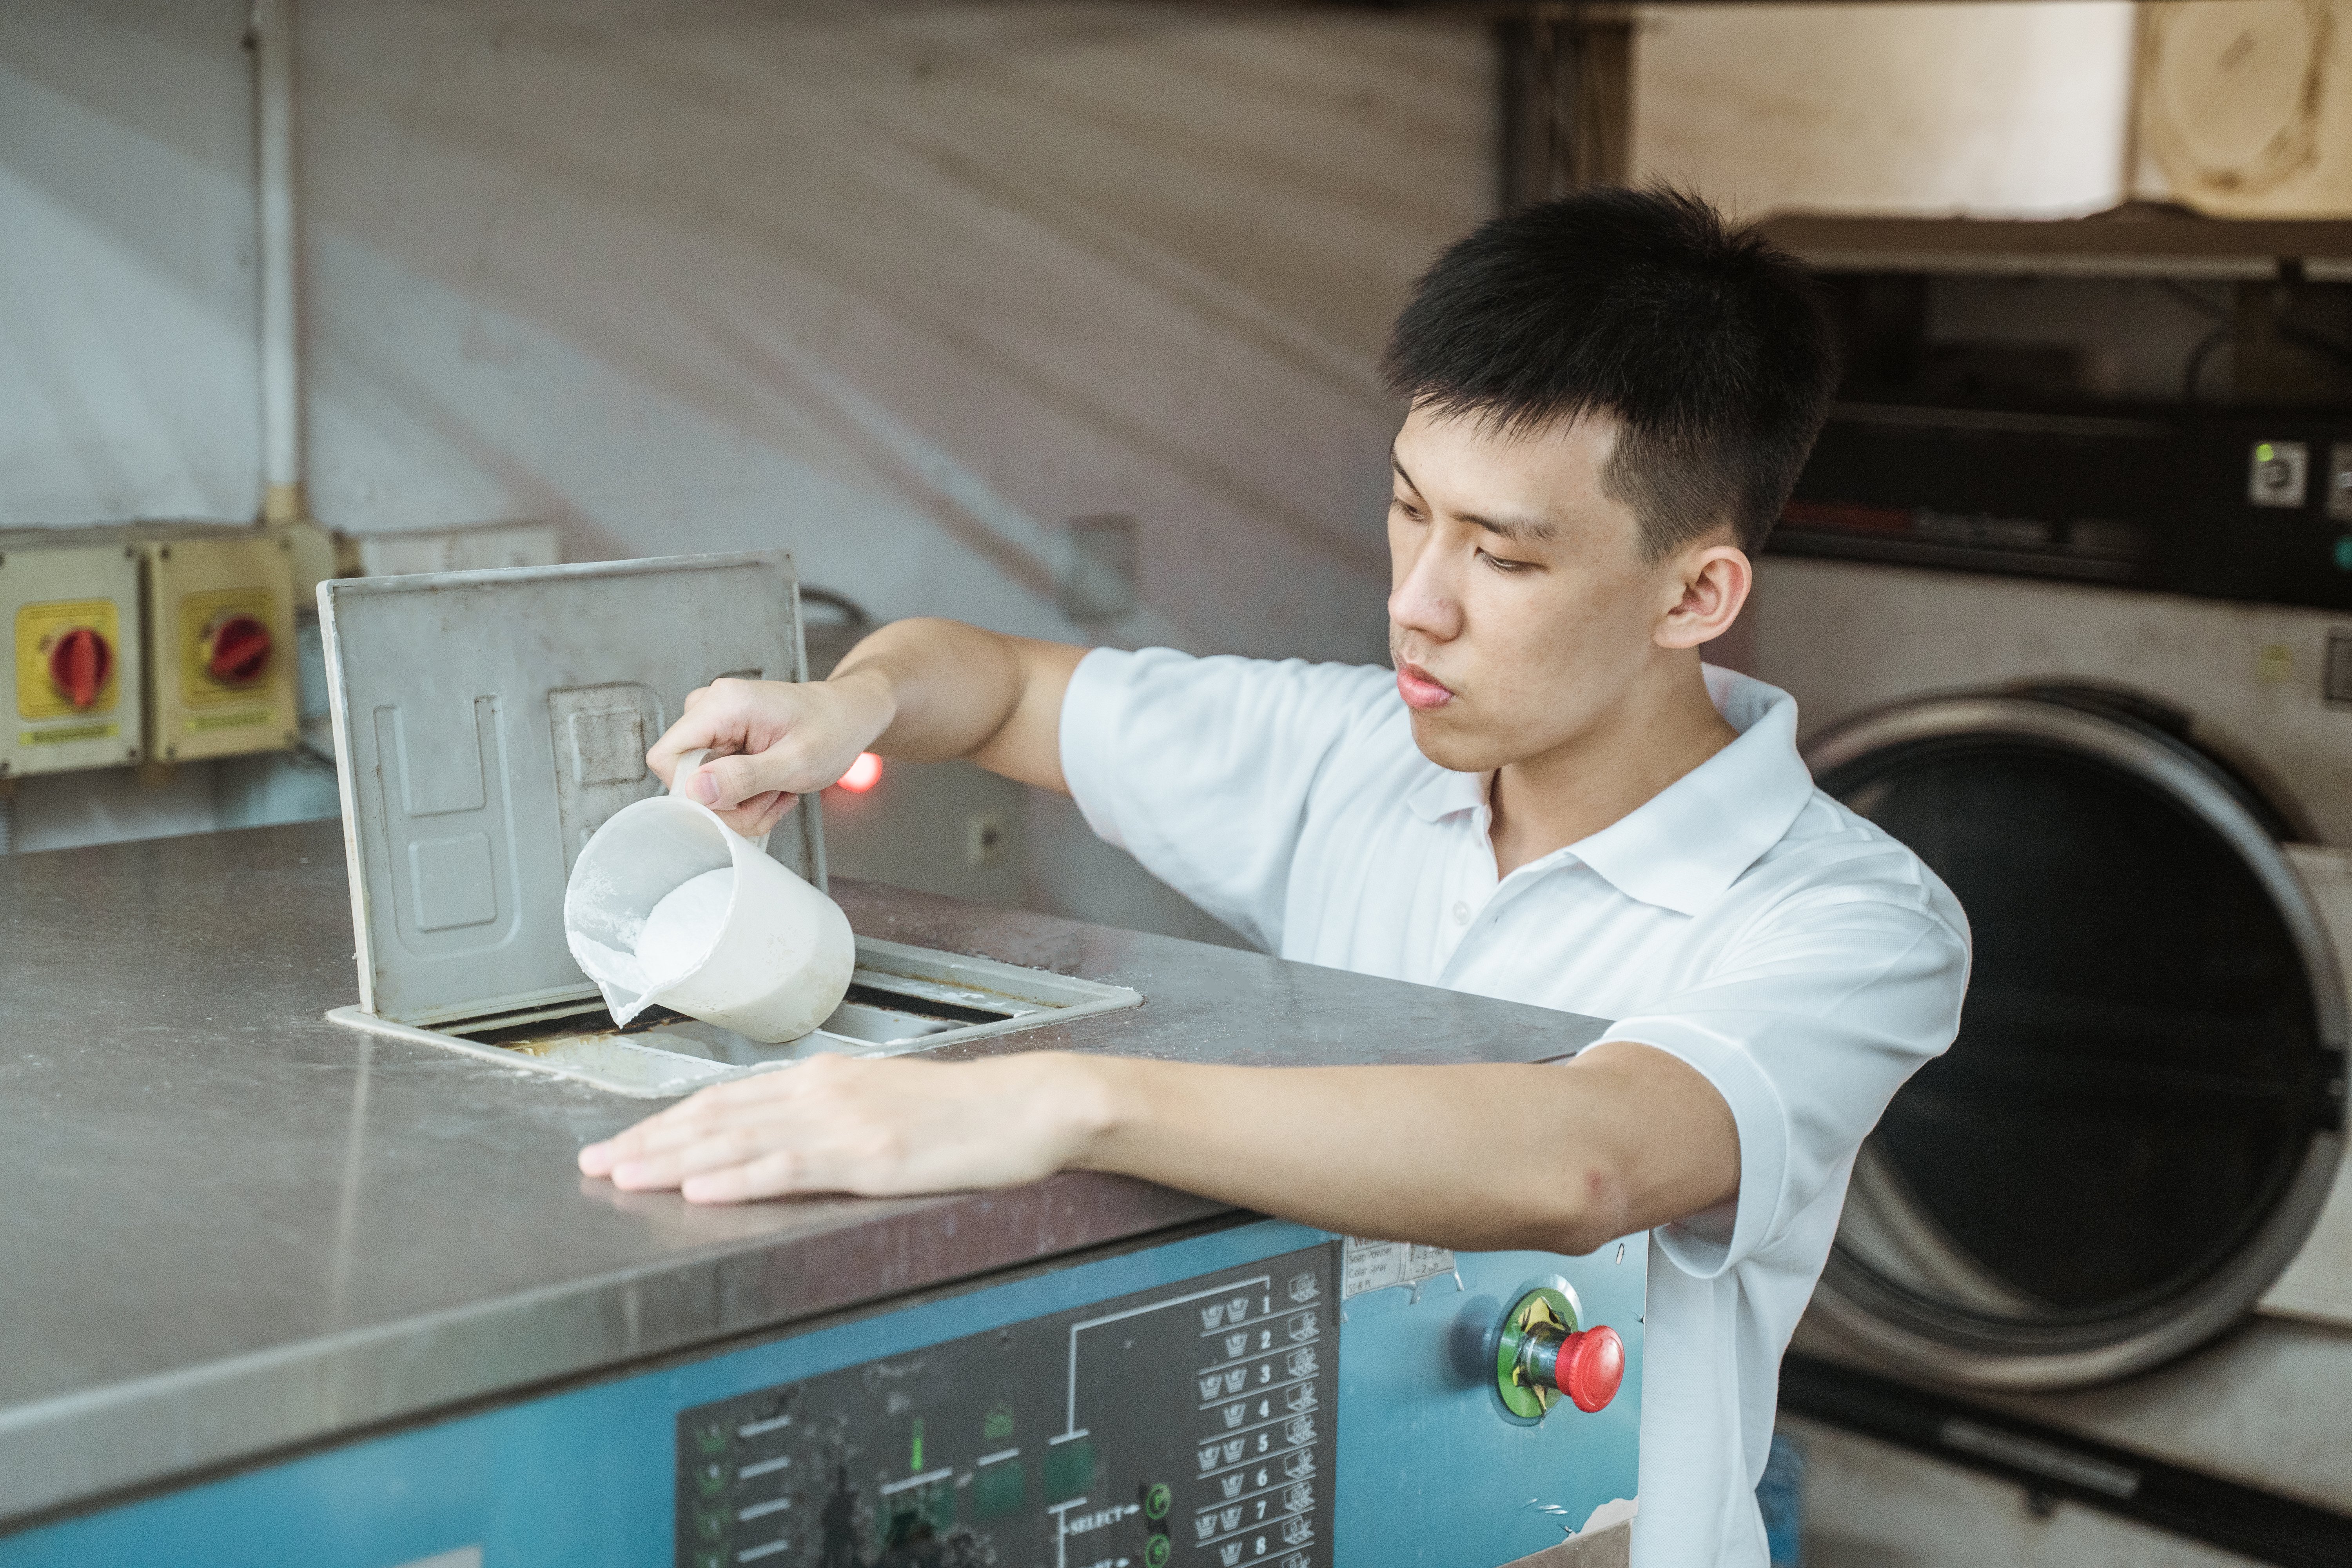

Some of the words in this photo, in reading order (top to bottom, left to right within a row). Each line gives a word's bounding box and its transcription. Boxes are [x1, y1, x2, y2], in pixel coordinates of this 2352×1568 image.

[1349, 1254, 1366, 1264] Soap
[1368, 1248, 1392, 1258] Powder
[1263, 1295, 1270, 1313] 1
[1261, 1330, 1271, 1349] 2
[1260, 1364, 1270, 1384] 3
[1259, 1399, 1269, 1417] 4
[1258, 1433, 1269, 1452] 5
[1257, 1468, 1268, 1486] 6
[1257, 1501, 1266, 1519] 7
[1070, 1505, 1122, 1535] SELECT
[1256, 1535, 1266, 1555] 8
